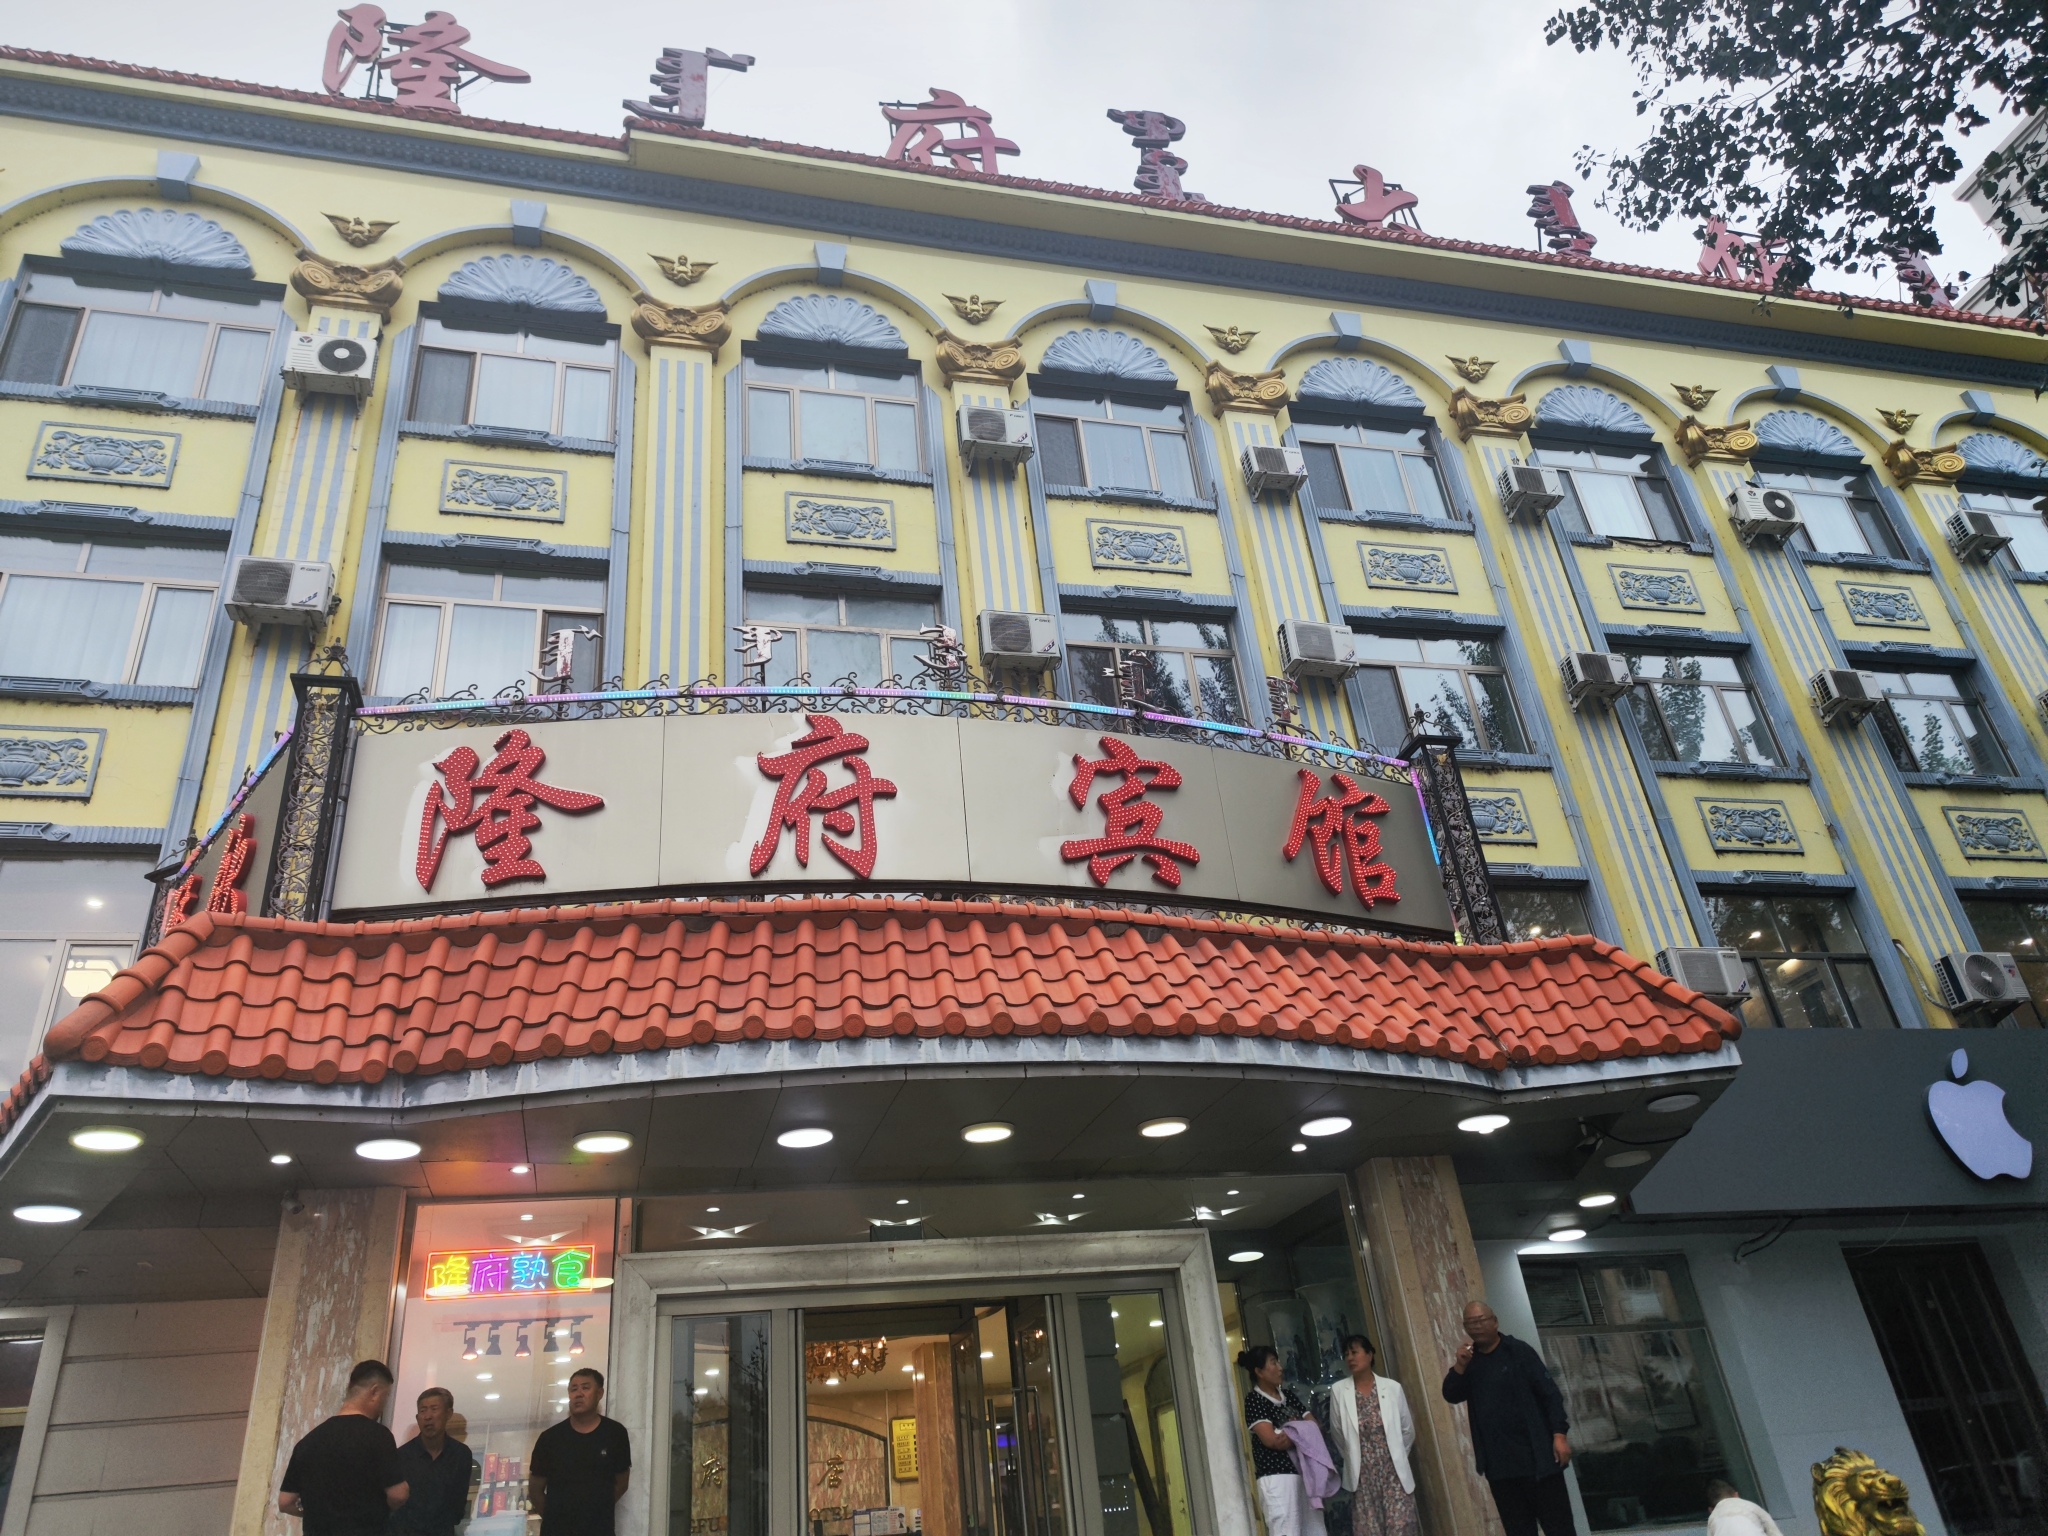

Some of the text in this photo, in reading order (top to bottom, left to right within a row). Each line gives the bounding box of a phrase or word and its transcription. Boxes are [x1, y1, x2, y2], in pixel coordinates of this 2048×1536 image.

[415, 713, 1401, 911] 隆府宾馆
[431, 1249, 591, 1294] 隆府熟食
